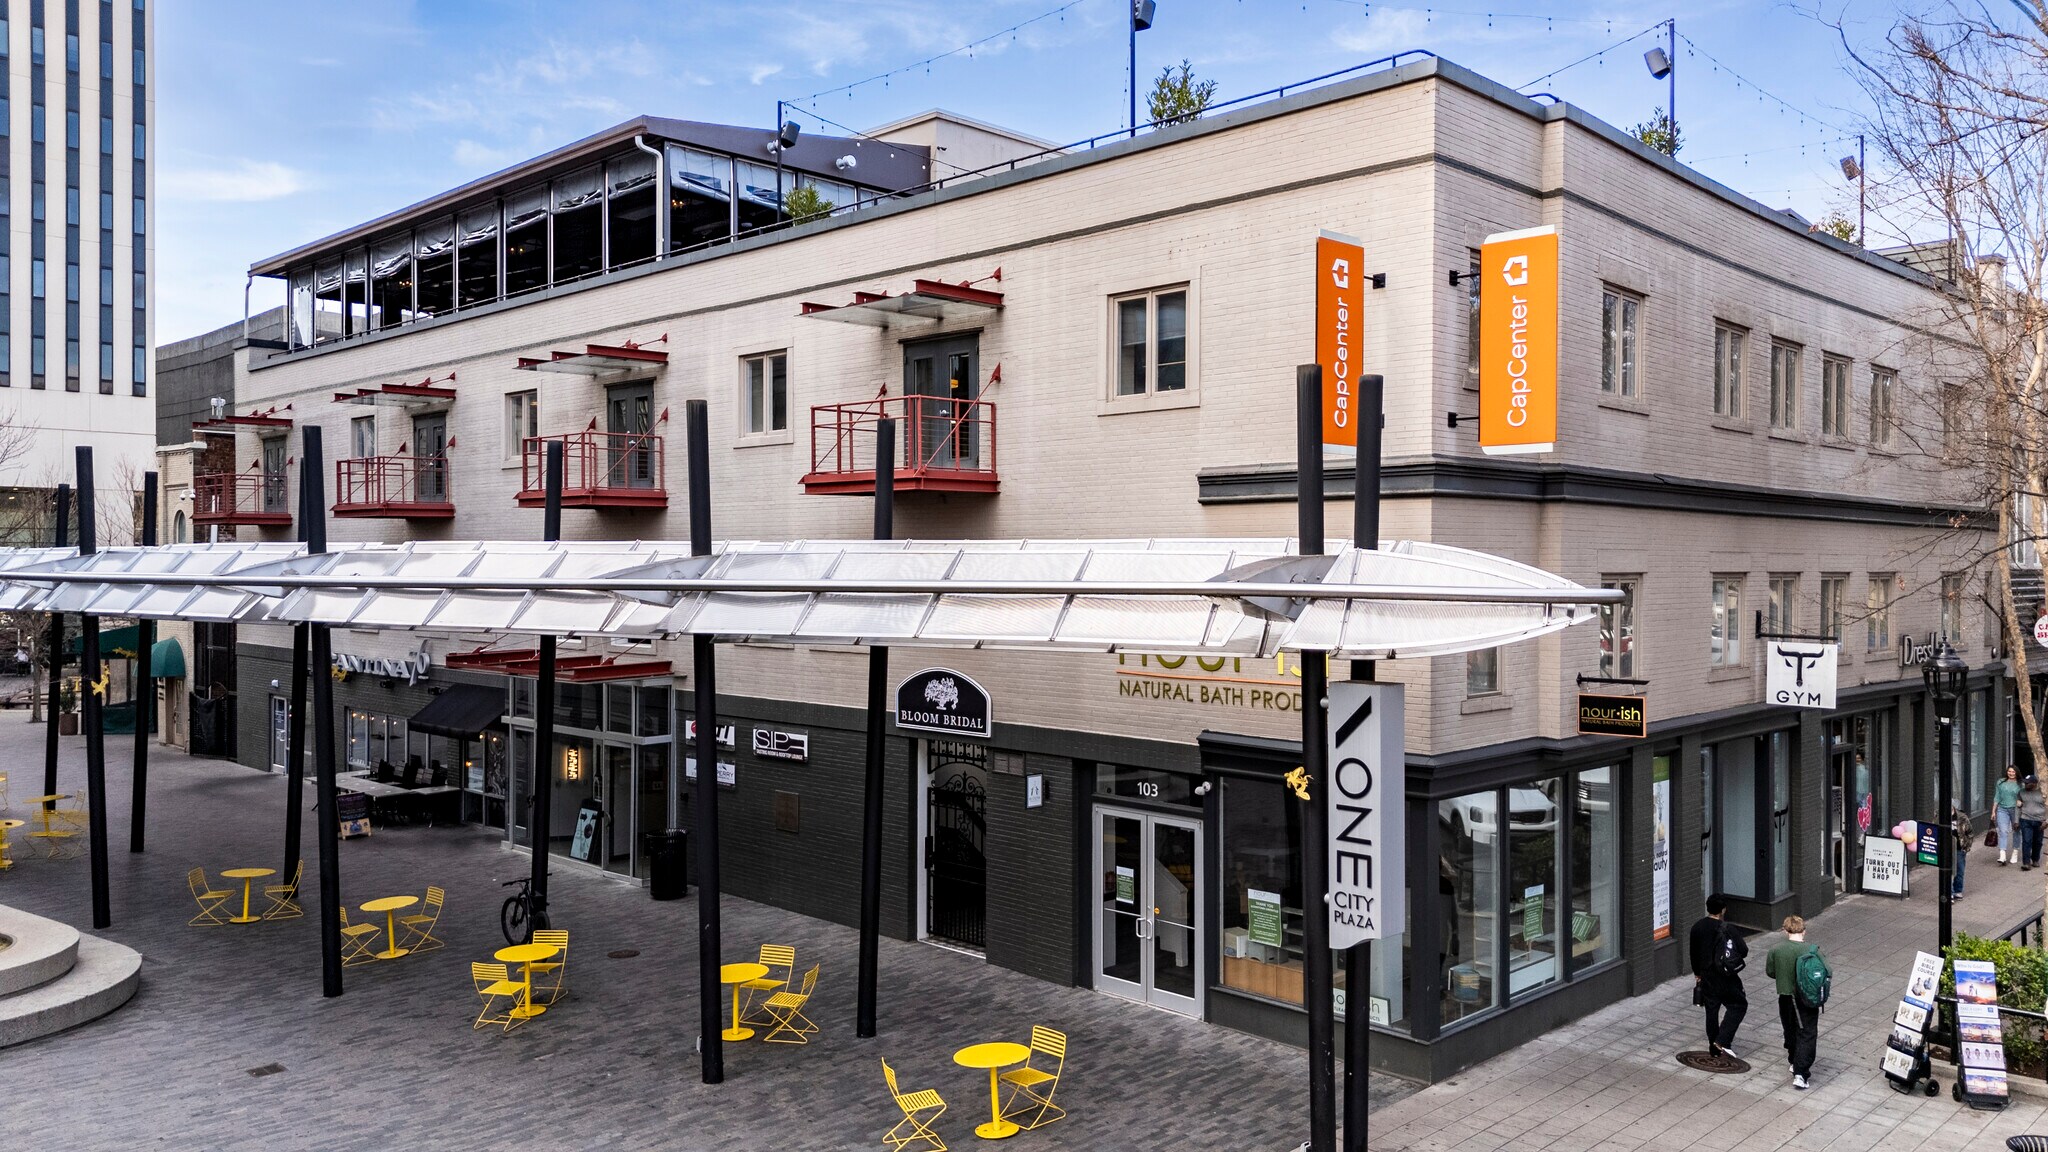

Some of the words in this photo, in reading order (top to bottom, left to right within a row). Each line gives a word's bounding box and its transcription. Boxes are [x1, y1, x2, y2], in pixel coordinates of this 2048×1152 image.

[1333, 297, 1350, 428] CapCenter
[1507, 295, 1531, 428] CapCenter
[1119, 679, 1194, 703] NATURAL
[1200, 685, 1244, 706] BATH
[1776, 690, 1821, 706] GYM
[901, 709, 939, 724] BLOOM
[943, 714, 984, 729] BRIDAL
[755, 729, 789, 750] SIP
[1137, 781, 1159, 798] 103
[1334, 757, 1373, 889] ONE
[1866, 858, 1885, 868] TURNS
[1887, 861, 1900, 869] OUT
[1872, 866, 1889, 874] HAVE
[1872, 873, 1890, 881] SHOP
[1334, 891, 1374, 912] CITY
[1334, 909, 1375, 931] PLAZA
[1917, 967, 1936, 977] COURSE
[1921, 962, 1935, 971] BIBLE
